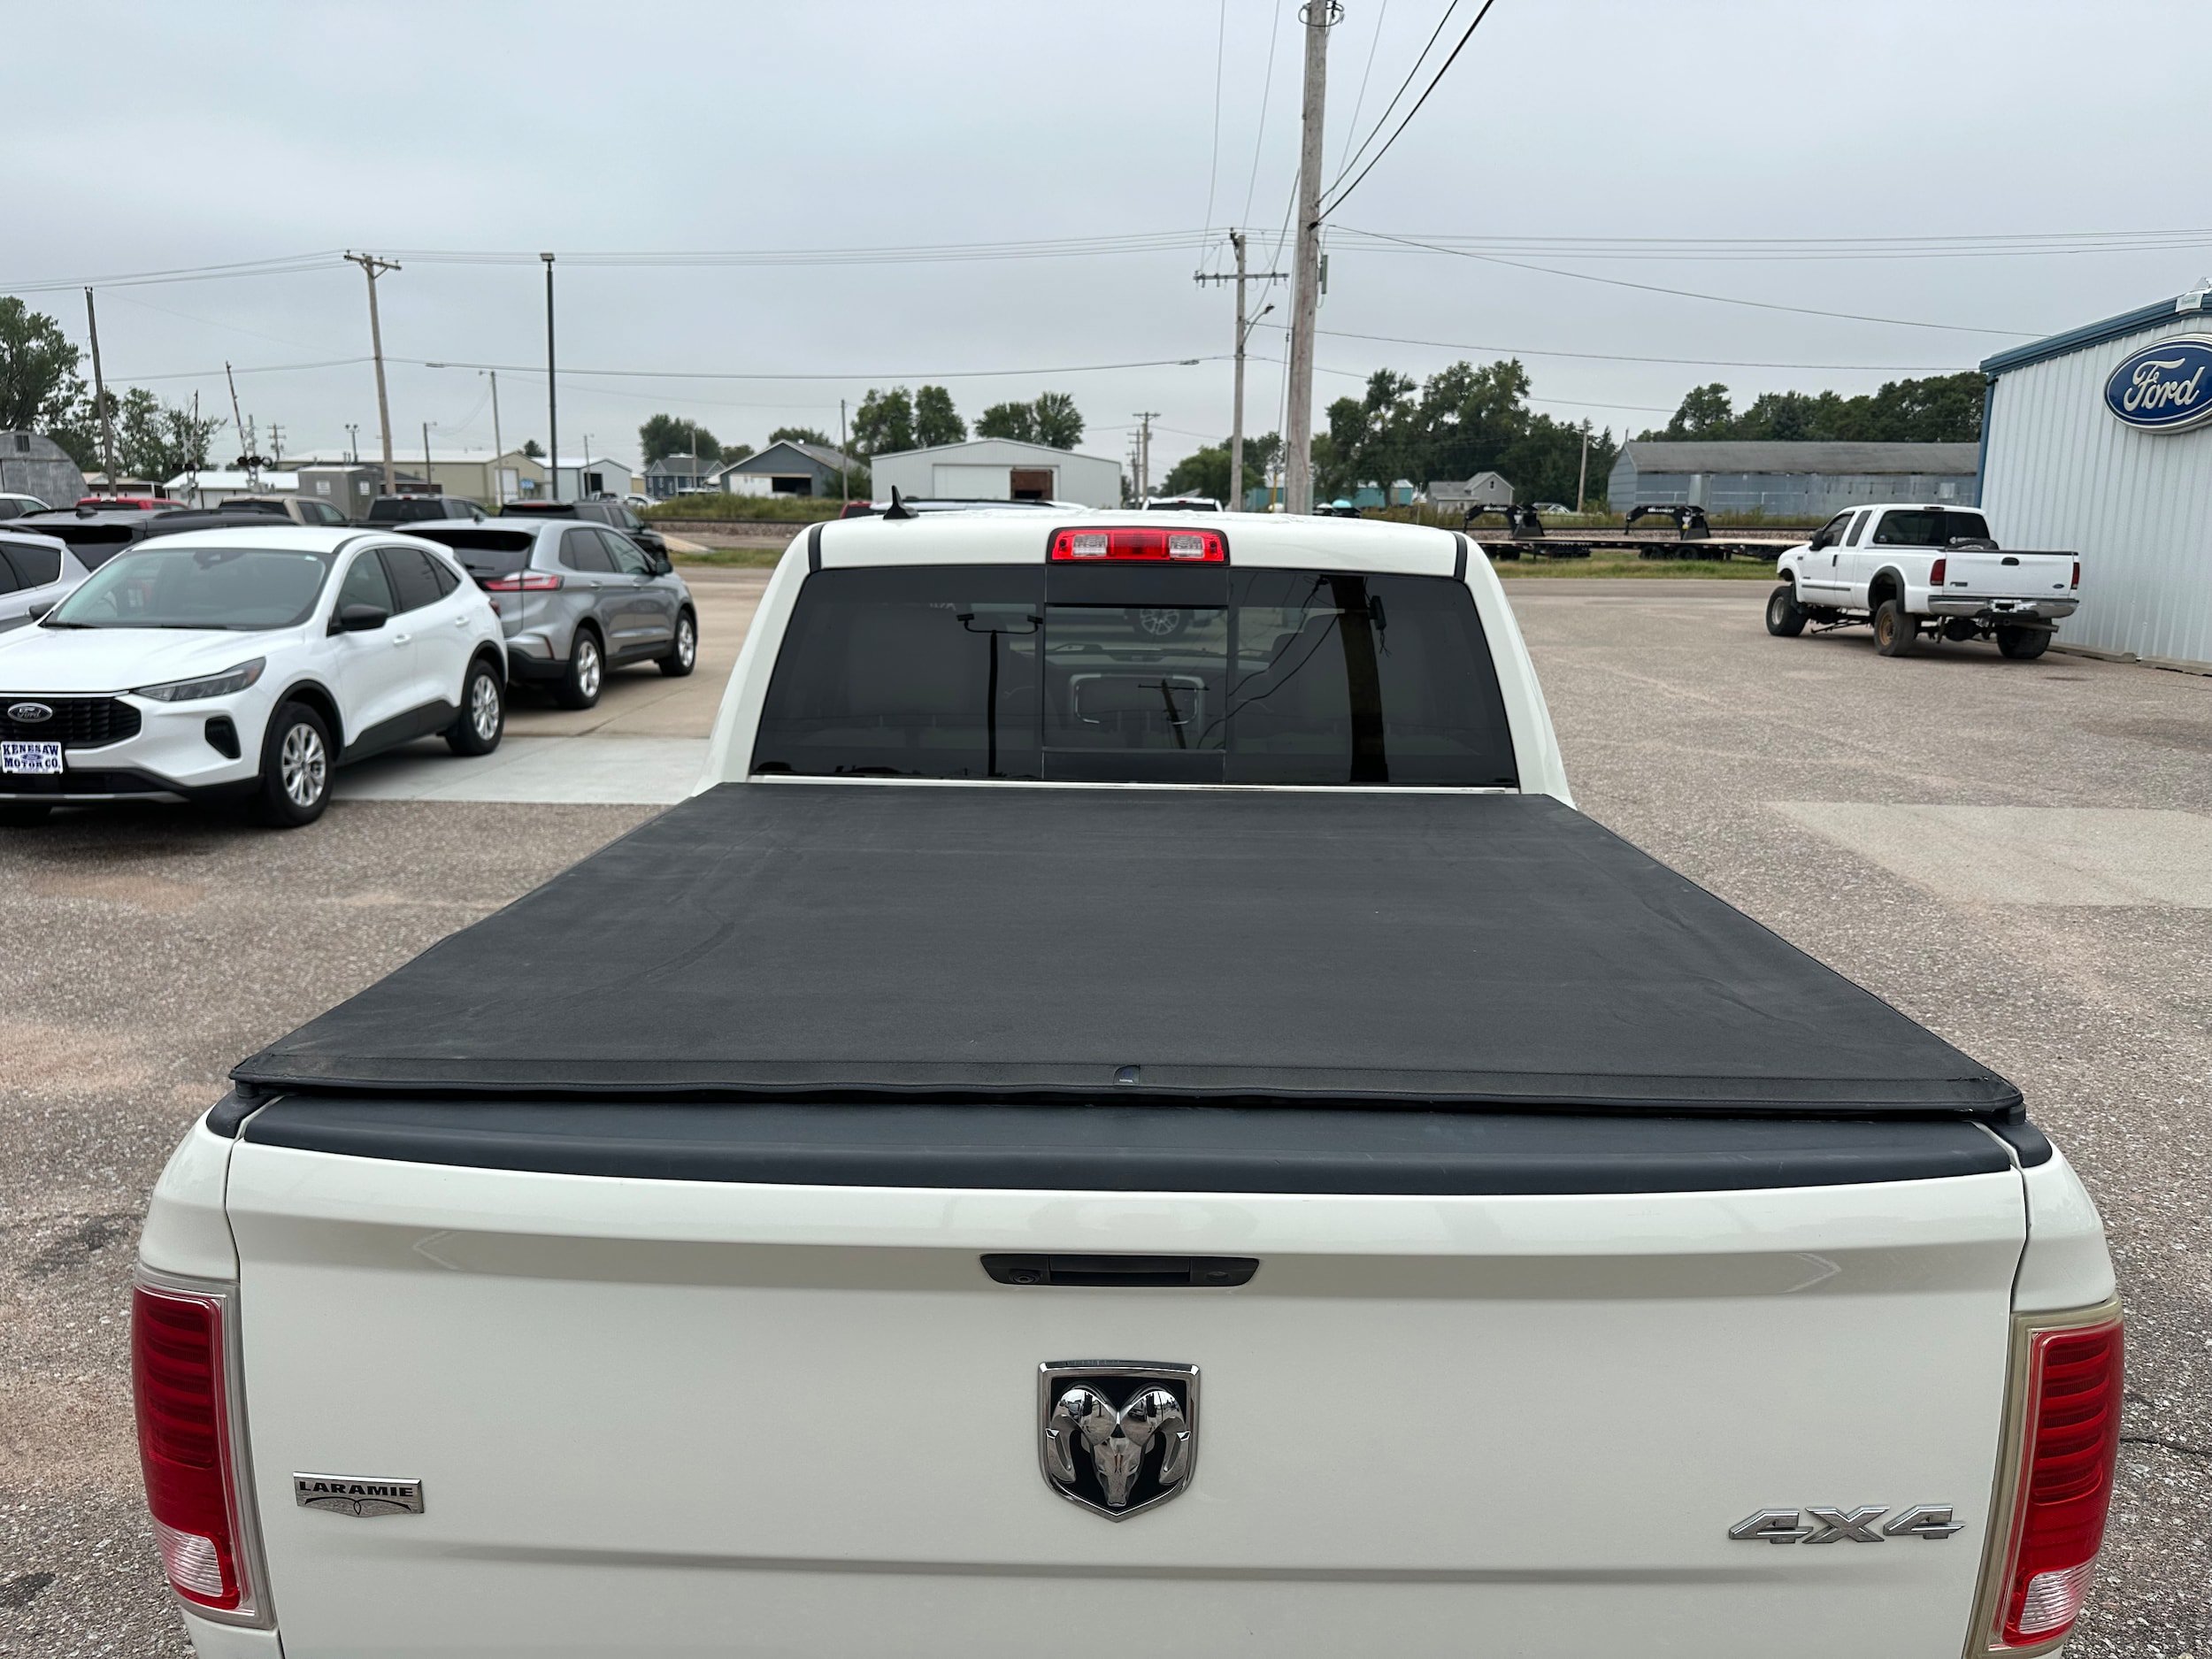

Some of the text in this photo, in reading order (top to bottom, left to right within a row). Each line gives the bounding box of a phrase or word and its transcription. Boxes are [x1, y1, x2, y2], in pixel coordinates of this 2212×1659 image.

[2124, 357, 2206, 411] Ford
[18, 707, 42, 719] Ford
[4, 757, 42, 768] MOTOR
[299, 1480, 413, 1497] LARAMIE
[1729, 1503, 1966, 1544] 4X4
